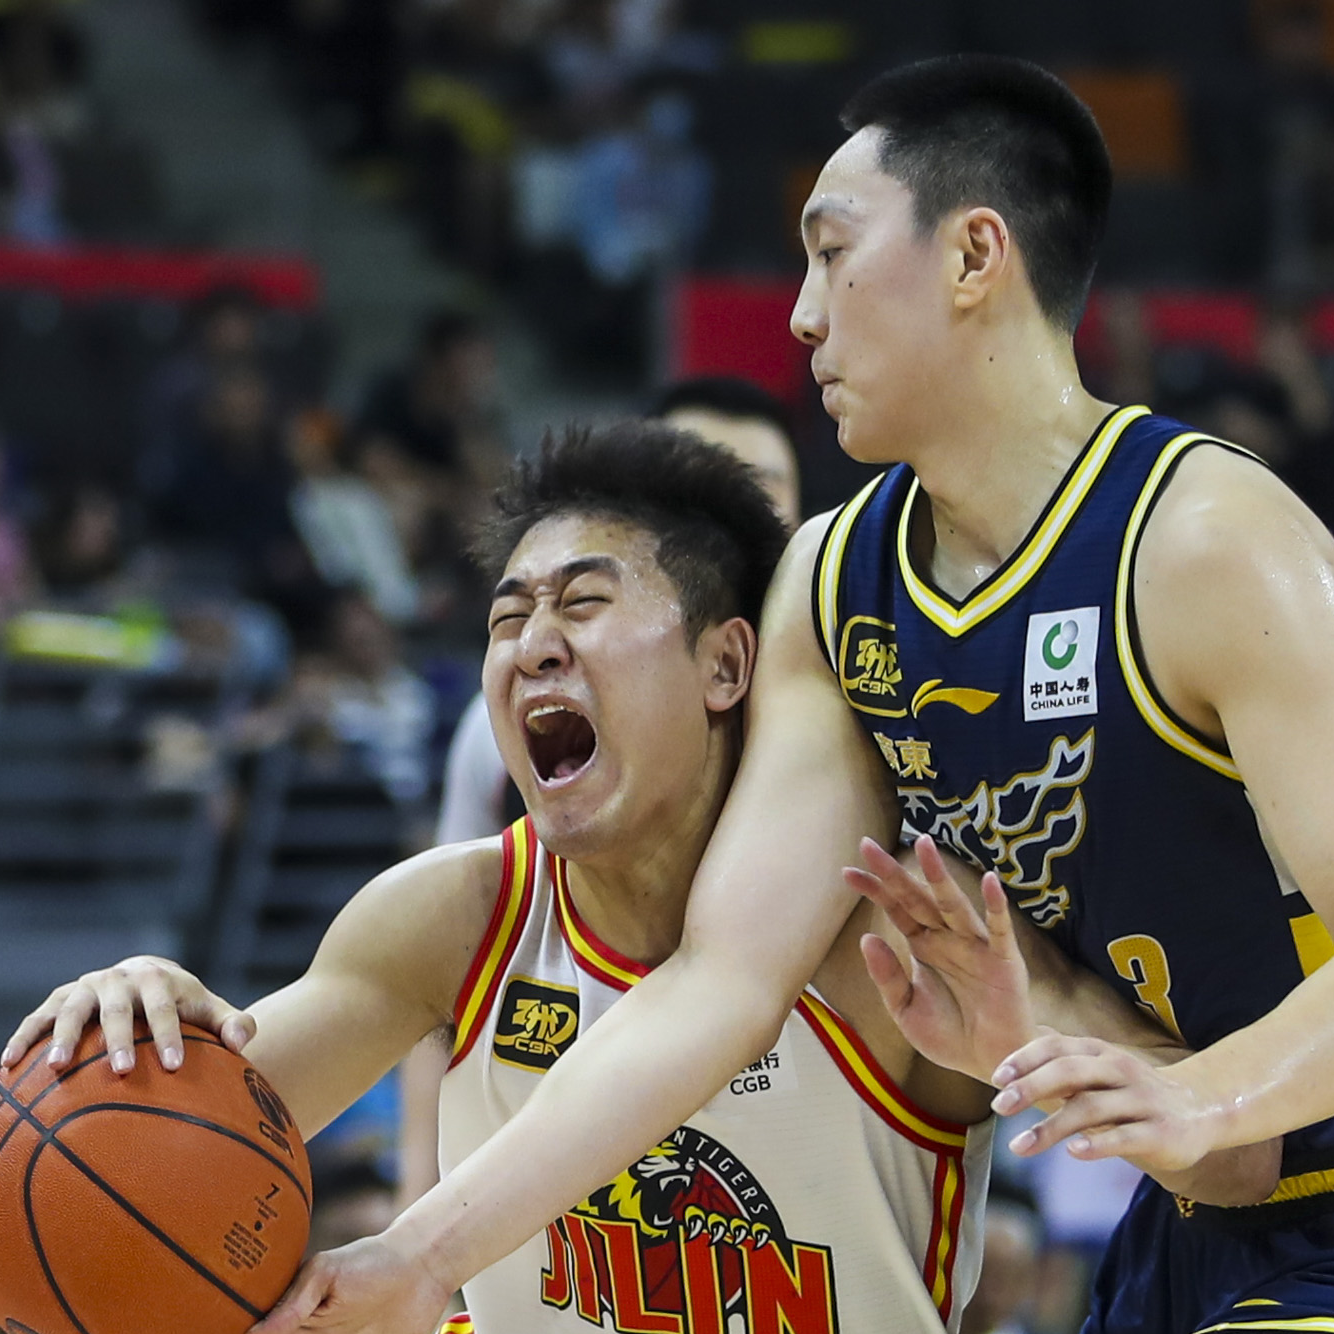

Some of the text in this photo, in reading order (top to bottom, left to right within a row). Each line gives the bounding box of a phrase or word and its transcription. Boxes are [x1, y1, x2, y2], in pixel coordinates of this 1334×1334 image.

[859, 679, 897, 697] CBA
[1030, 676, 1090, 699] 中国人寿
[1031, 694, 1090, 711] CHINA LIFE
[515, 1038, 560, 1057] CBA
[730, 1074, 772, 1095] CGB
[695, 1136, 769, 1215] TIGERS
